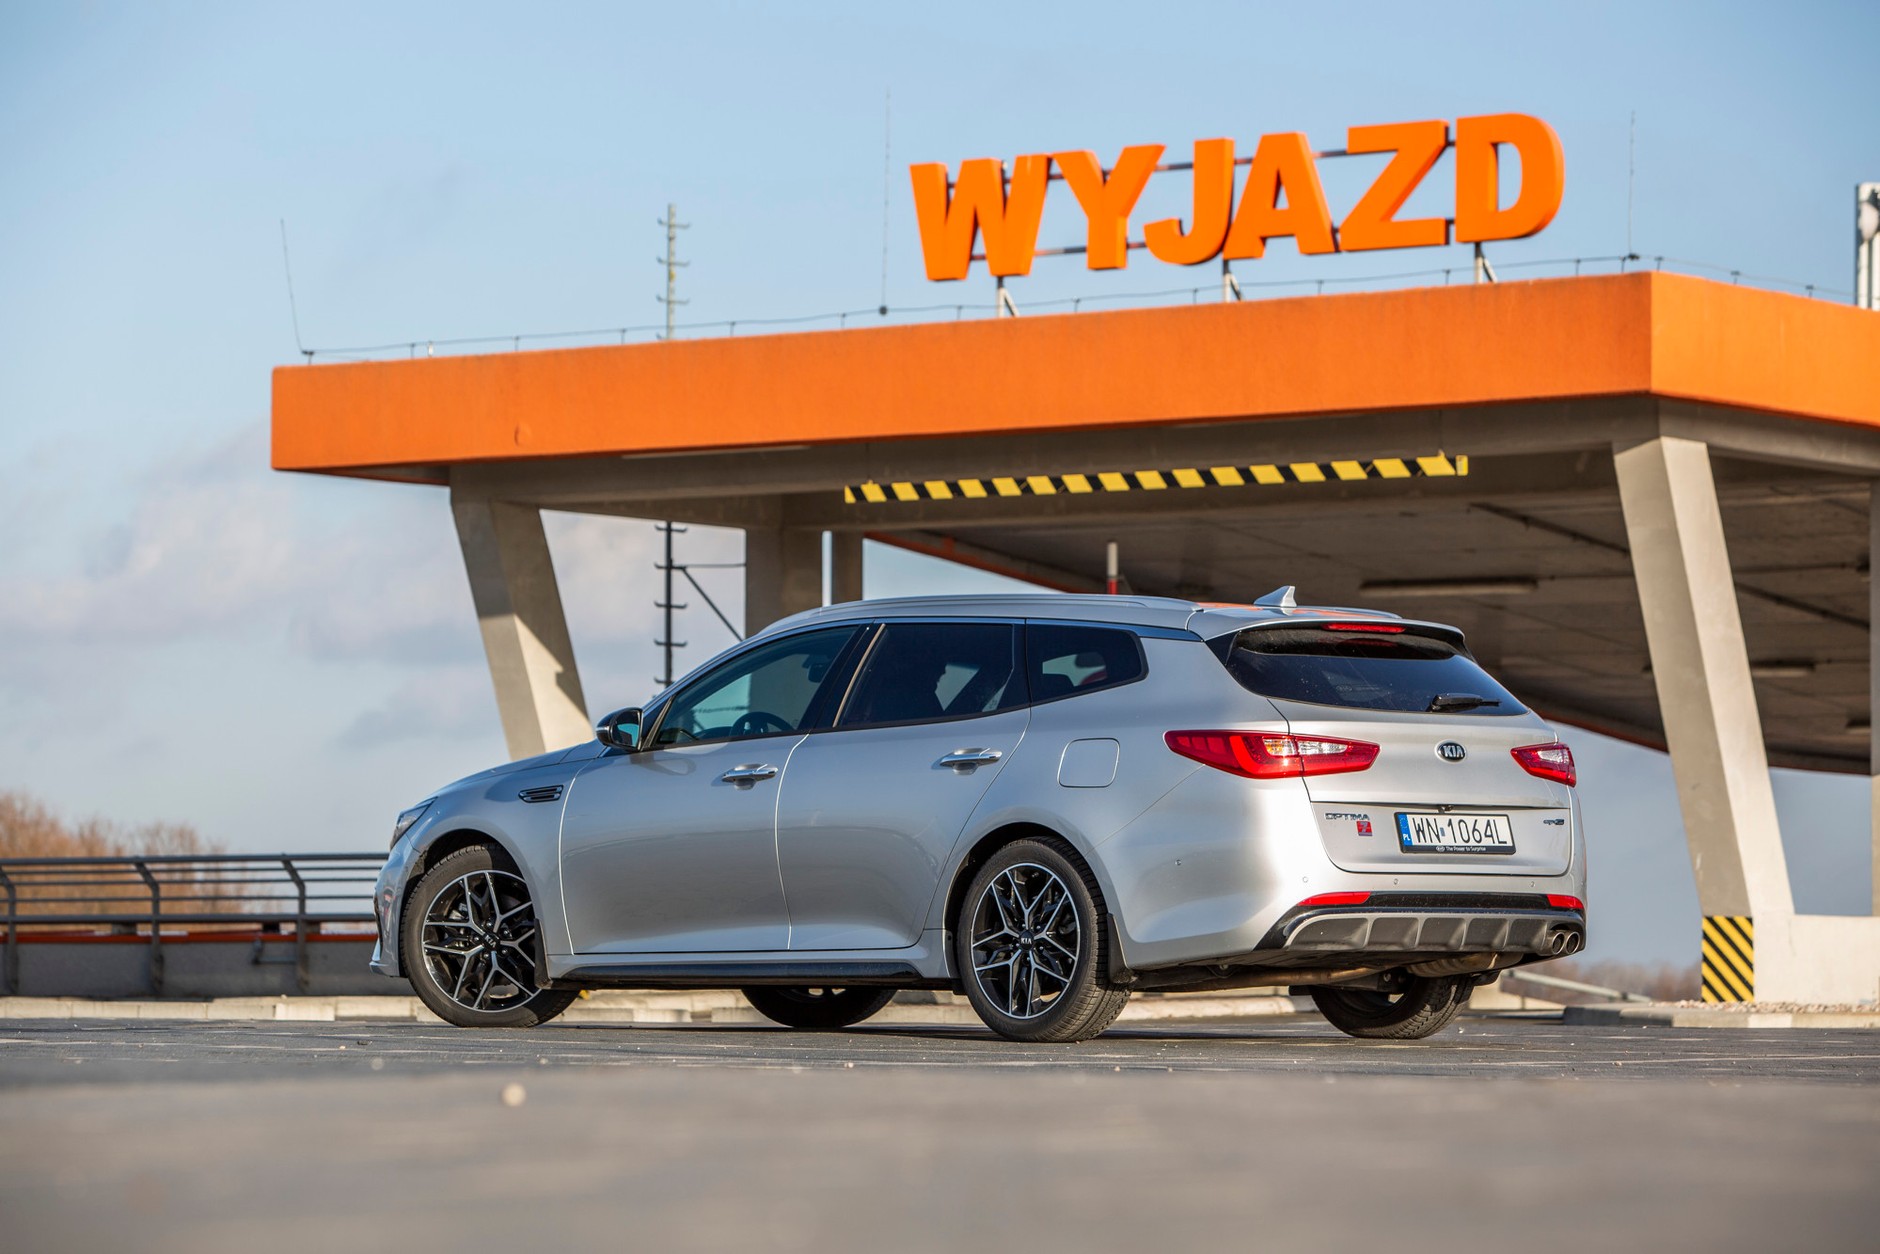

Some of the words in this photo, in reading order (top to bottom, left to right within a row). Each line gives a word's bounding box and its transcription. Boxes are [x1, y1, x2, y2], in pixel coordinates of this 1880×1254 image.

[909, 112, 1565, 282] WYJAZD
[1443, 745, 1464, 758] KIA
[1324, 812, 1370, 821] OPTIMA
[1403, 833, 1411, 841] PL
[1412, 817, 1442, 844] WN
[1447, 818, 1507, 844] 1064L
[485, 934, 497, 948] KIA
